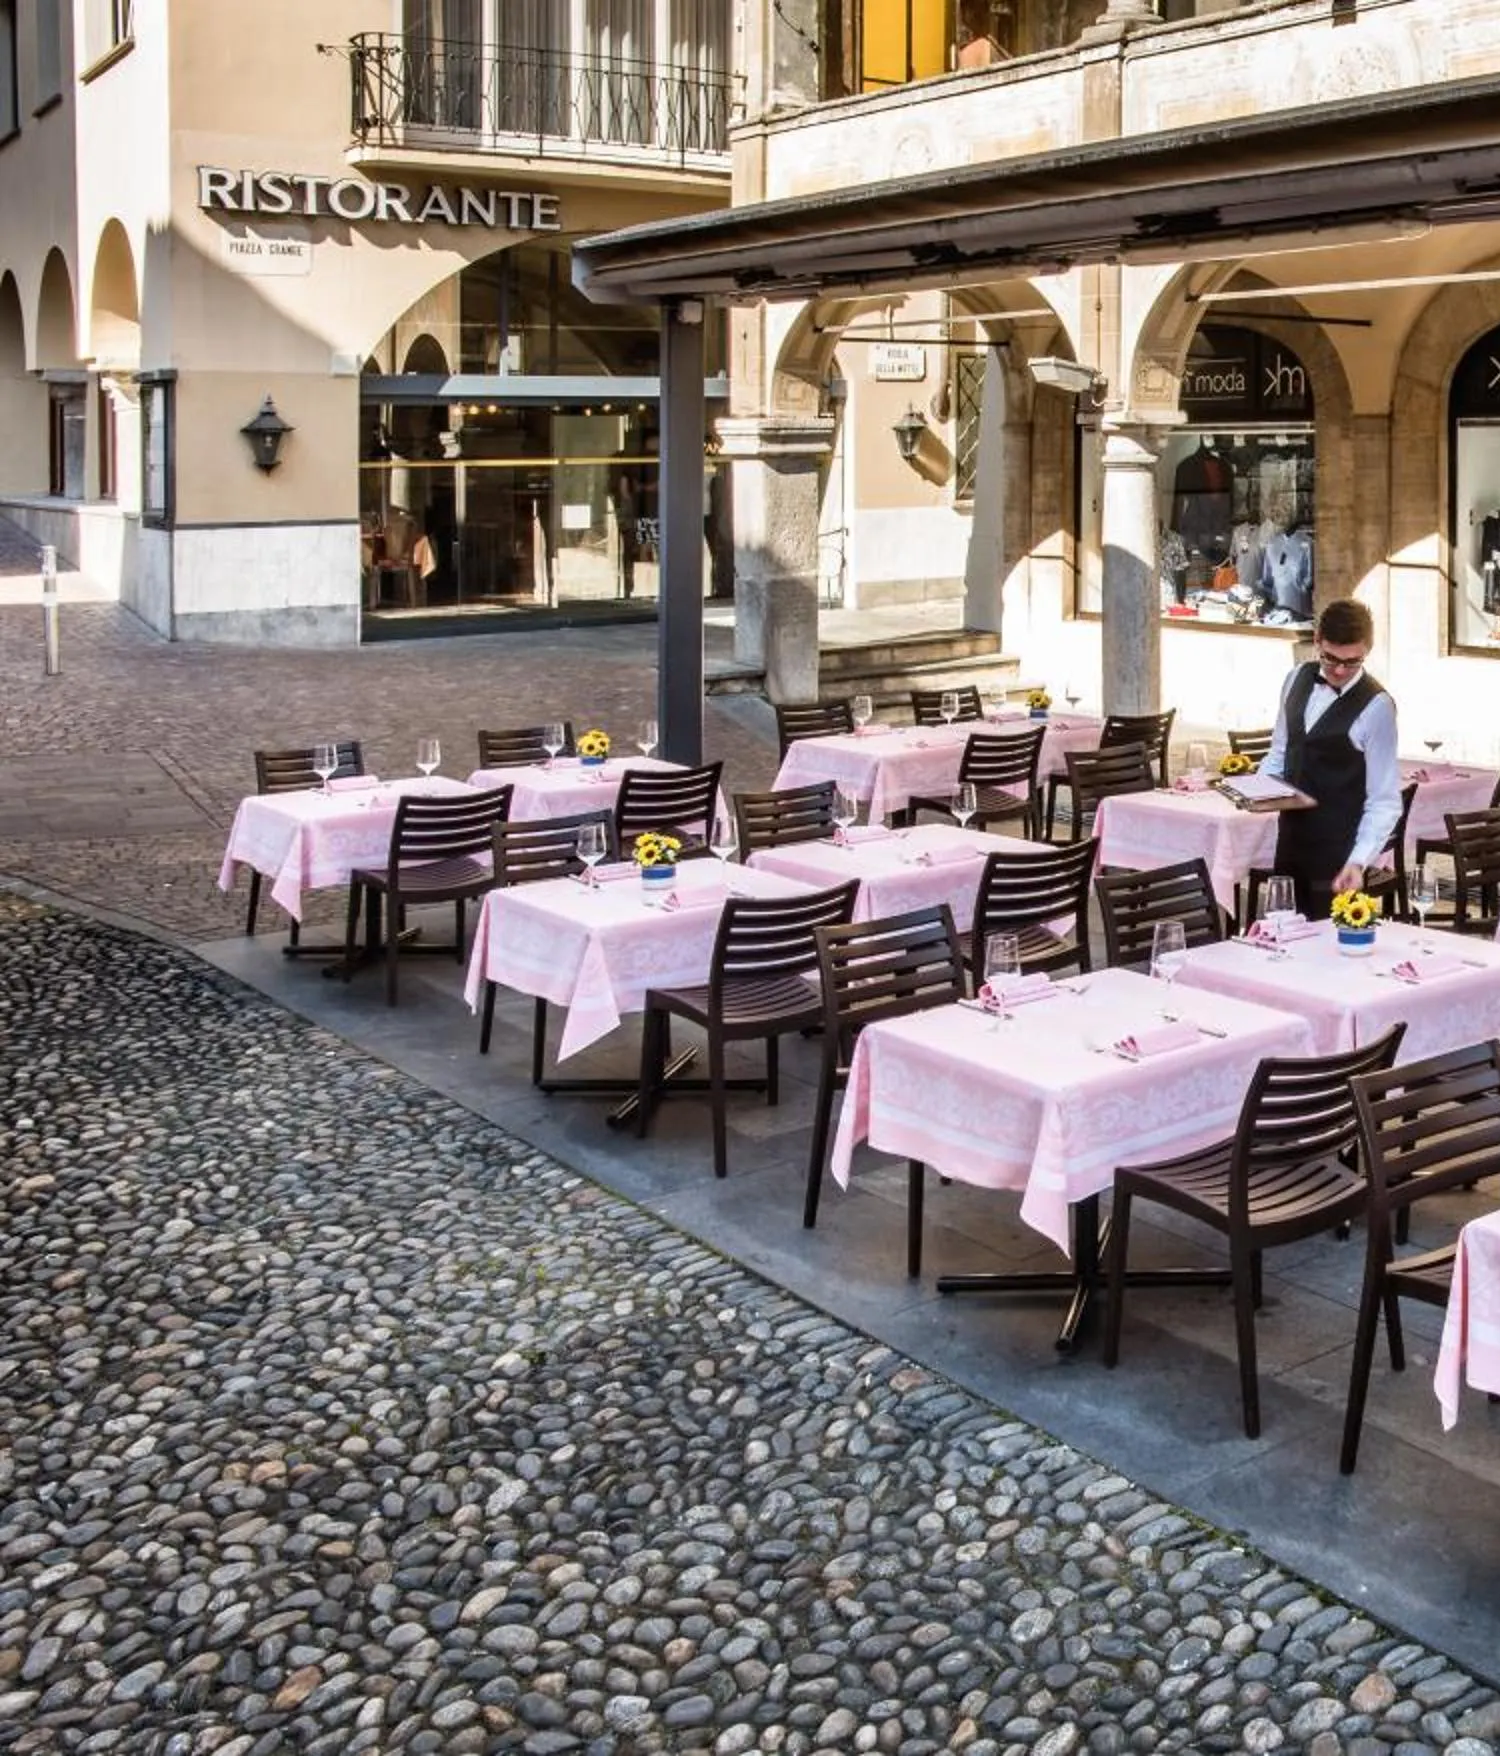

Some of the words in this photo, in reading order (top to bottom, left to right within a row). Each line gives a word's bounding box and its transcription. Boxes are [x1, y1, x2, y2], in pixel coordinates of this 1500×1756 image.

[197, 165, 562, 231] RISTORANTE
[229, 241, 263, 255] PIAZZA
[1195, 364, 1247, 394] moda
